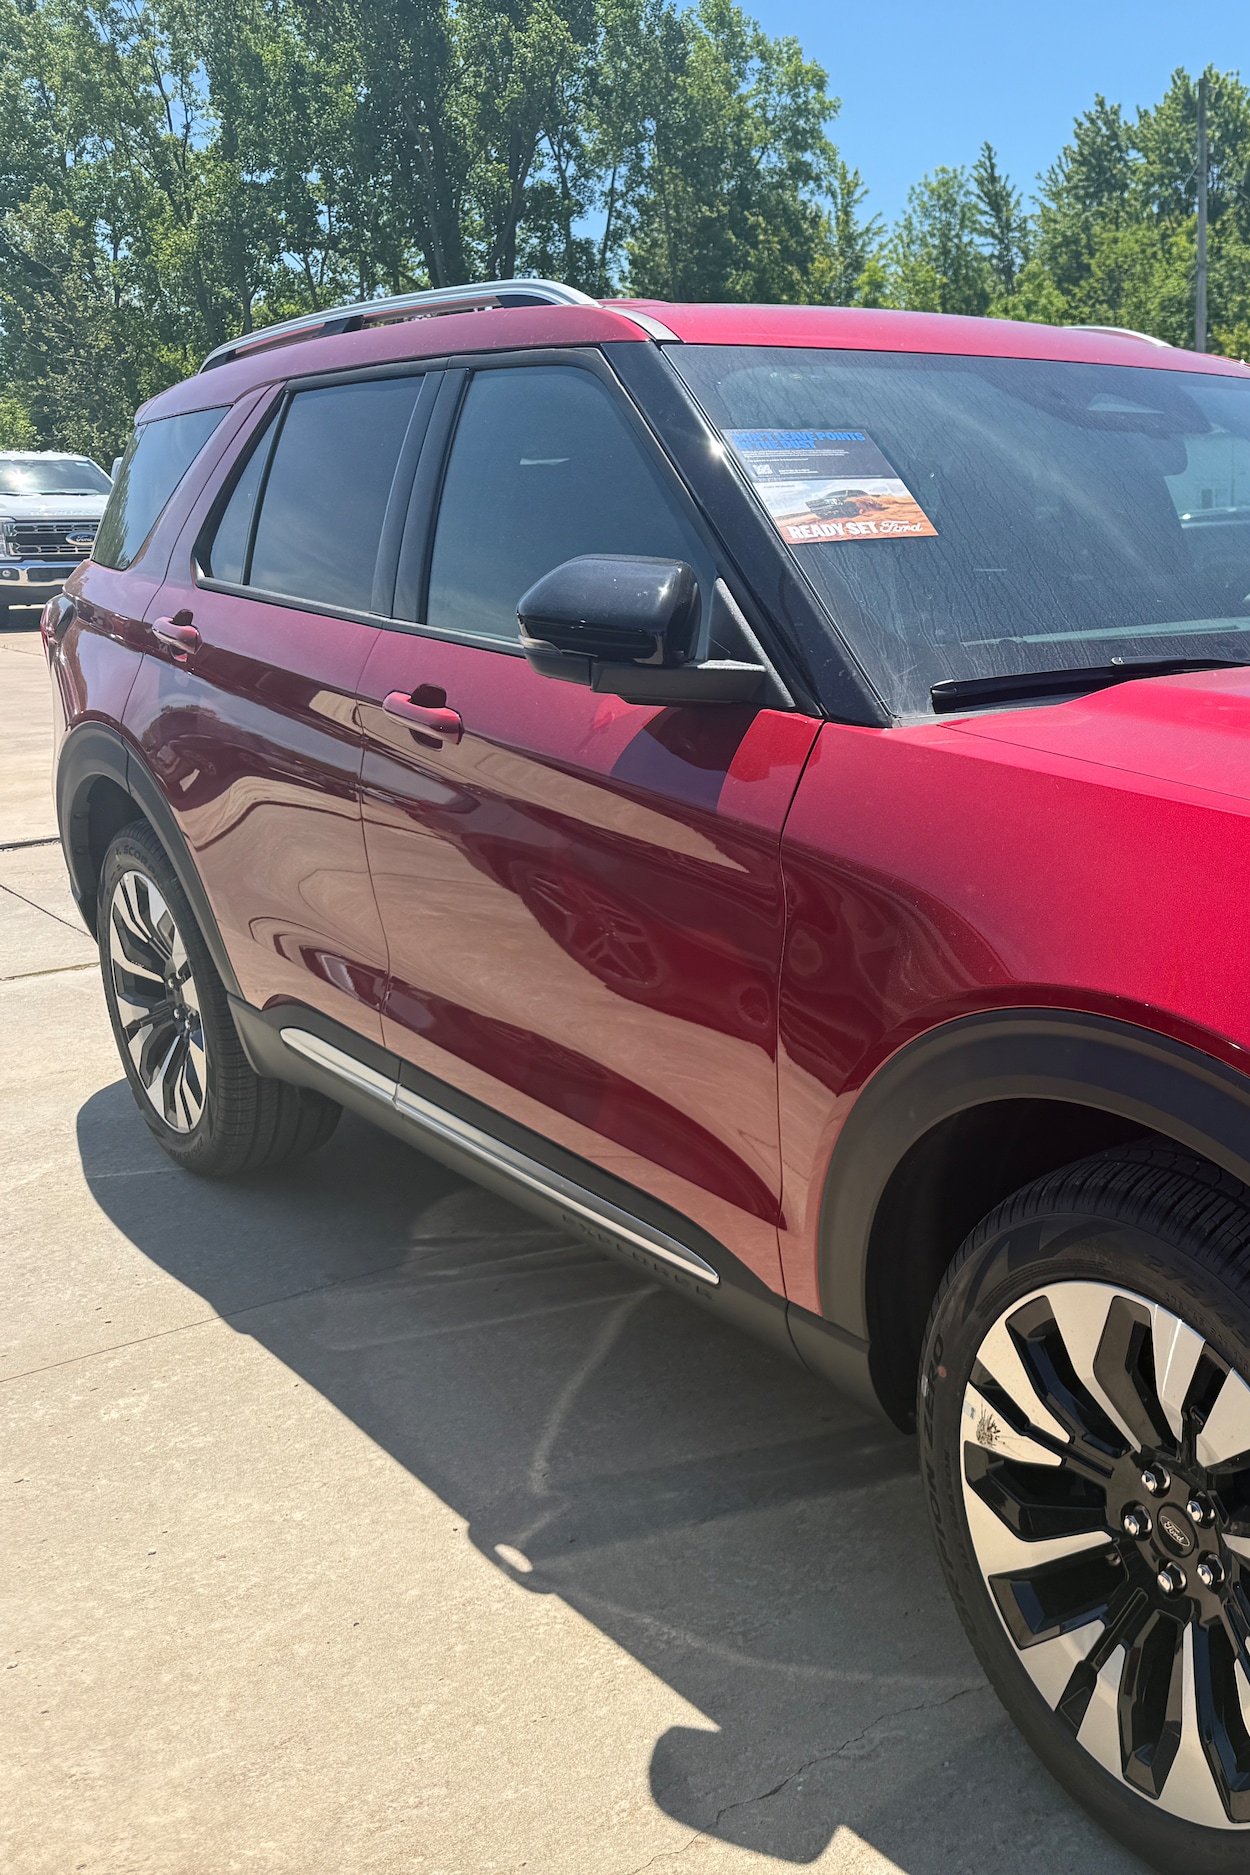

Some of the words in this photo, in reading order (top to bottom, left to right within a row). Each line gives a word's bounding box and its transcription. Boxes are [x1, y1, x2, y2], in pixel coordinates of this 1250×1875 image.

[731, 432, 774, 441] DON'T
[775, 432, 819, 441] LEAVE
[817, 432, 866, 441] POINTS
[735, 441, 754, 450] IN
[755, 441, 781, 450] THE
[781, 440, 817, 449] DUST
[787, 523, 845, 539] READY
[846, 521, 879, 535] SET
[880, 520, 923, 533] Ford
[1163, 1520, 1185, 1543] Ford
